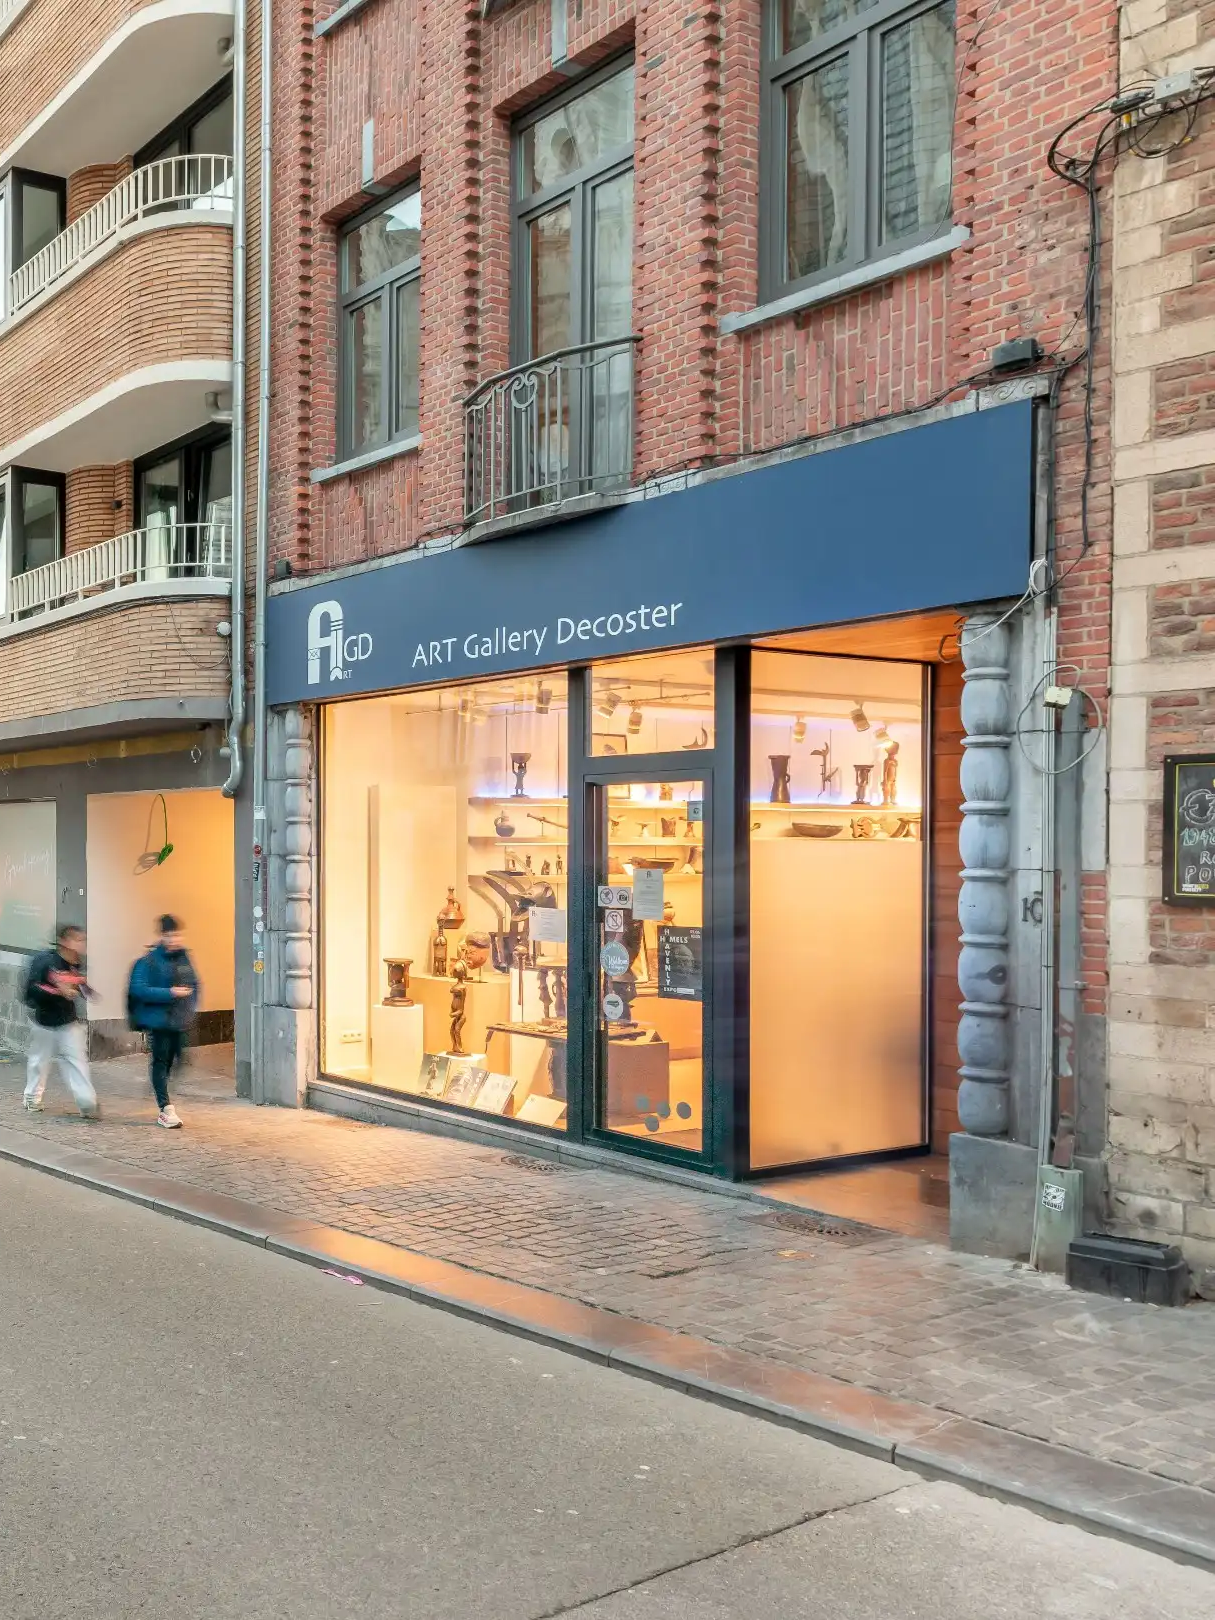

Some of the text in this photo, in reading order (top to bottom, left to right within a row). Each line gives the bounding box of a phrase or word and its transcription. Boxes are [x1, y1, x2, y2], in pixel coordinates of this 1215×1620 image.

[411, 602, 683, 668] ART Gallery Decoster
